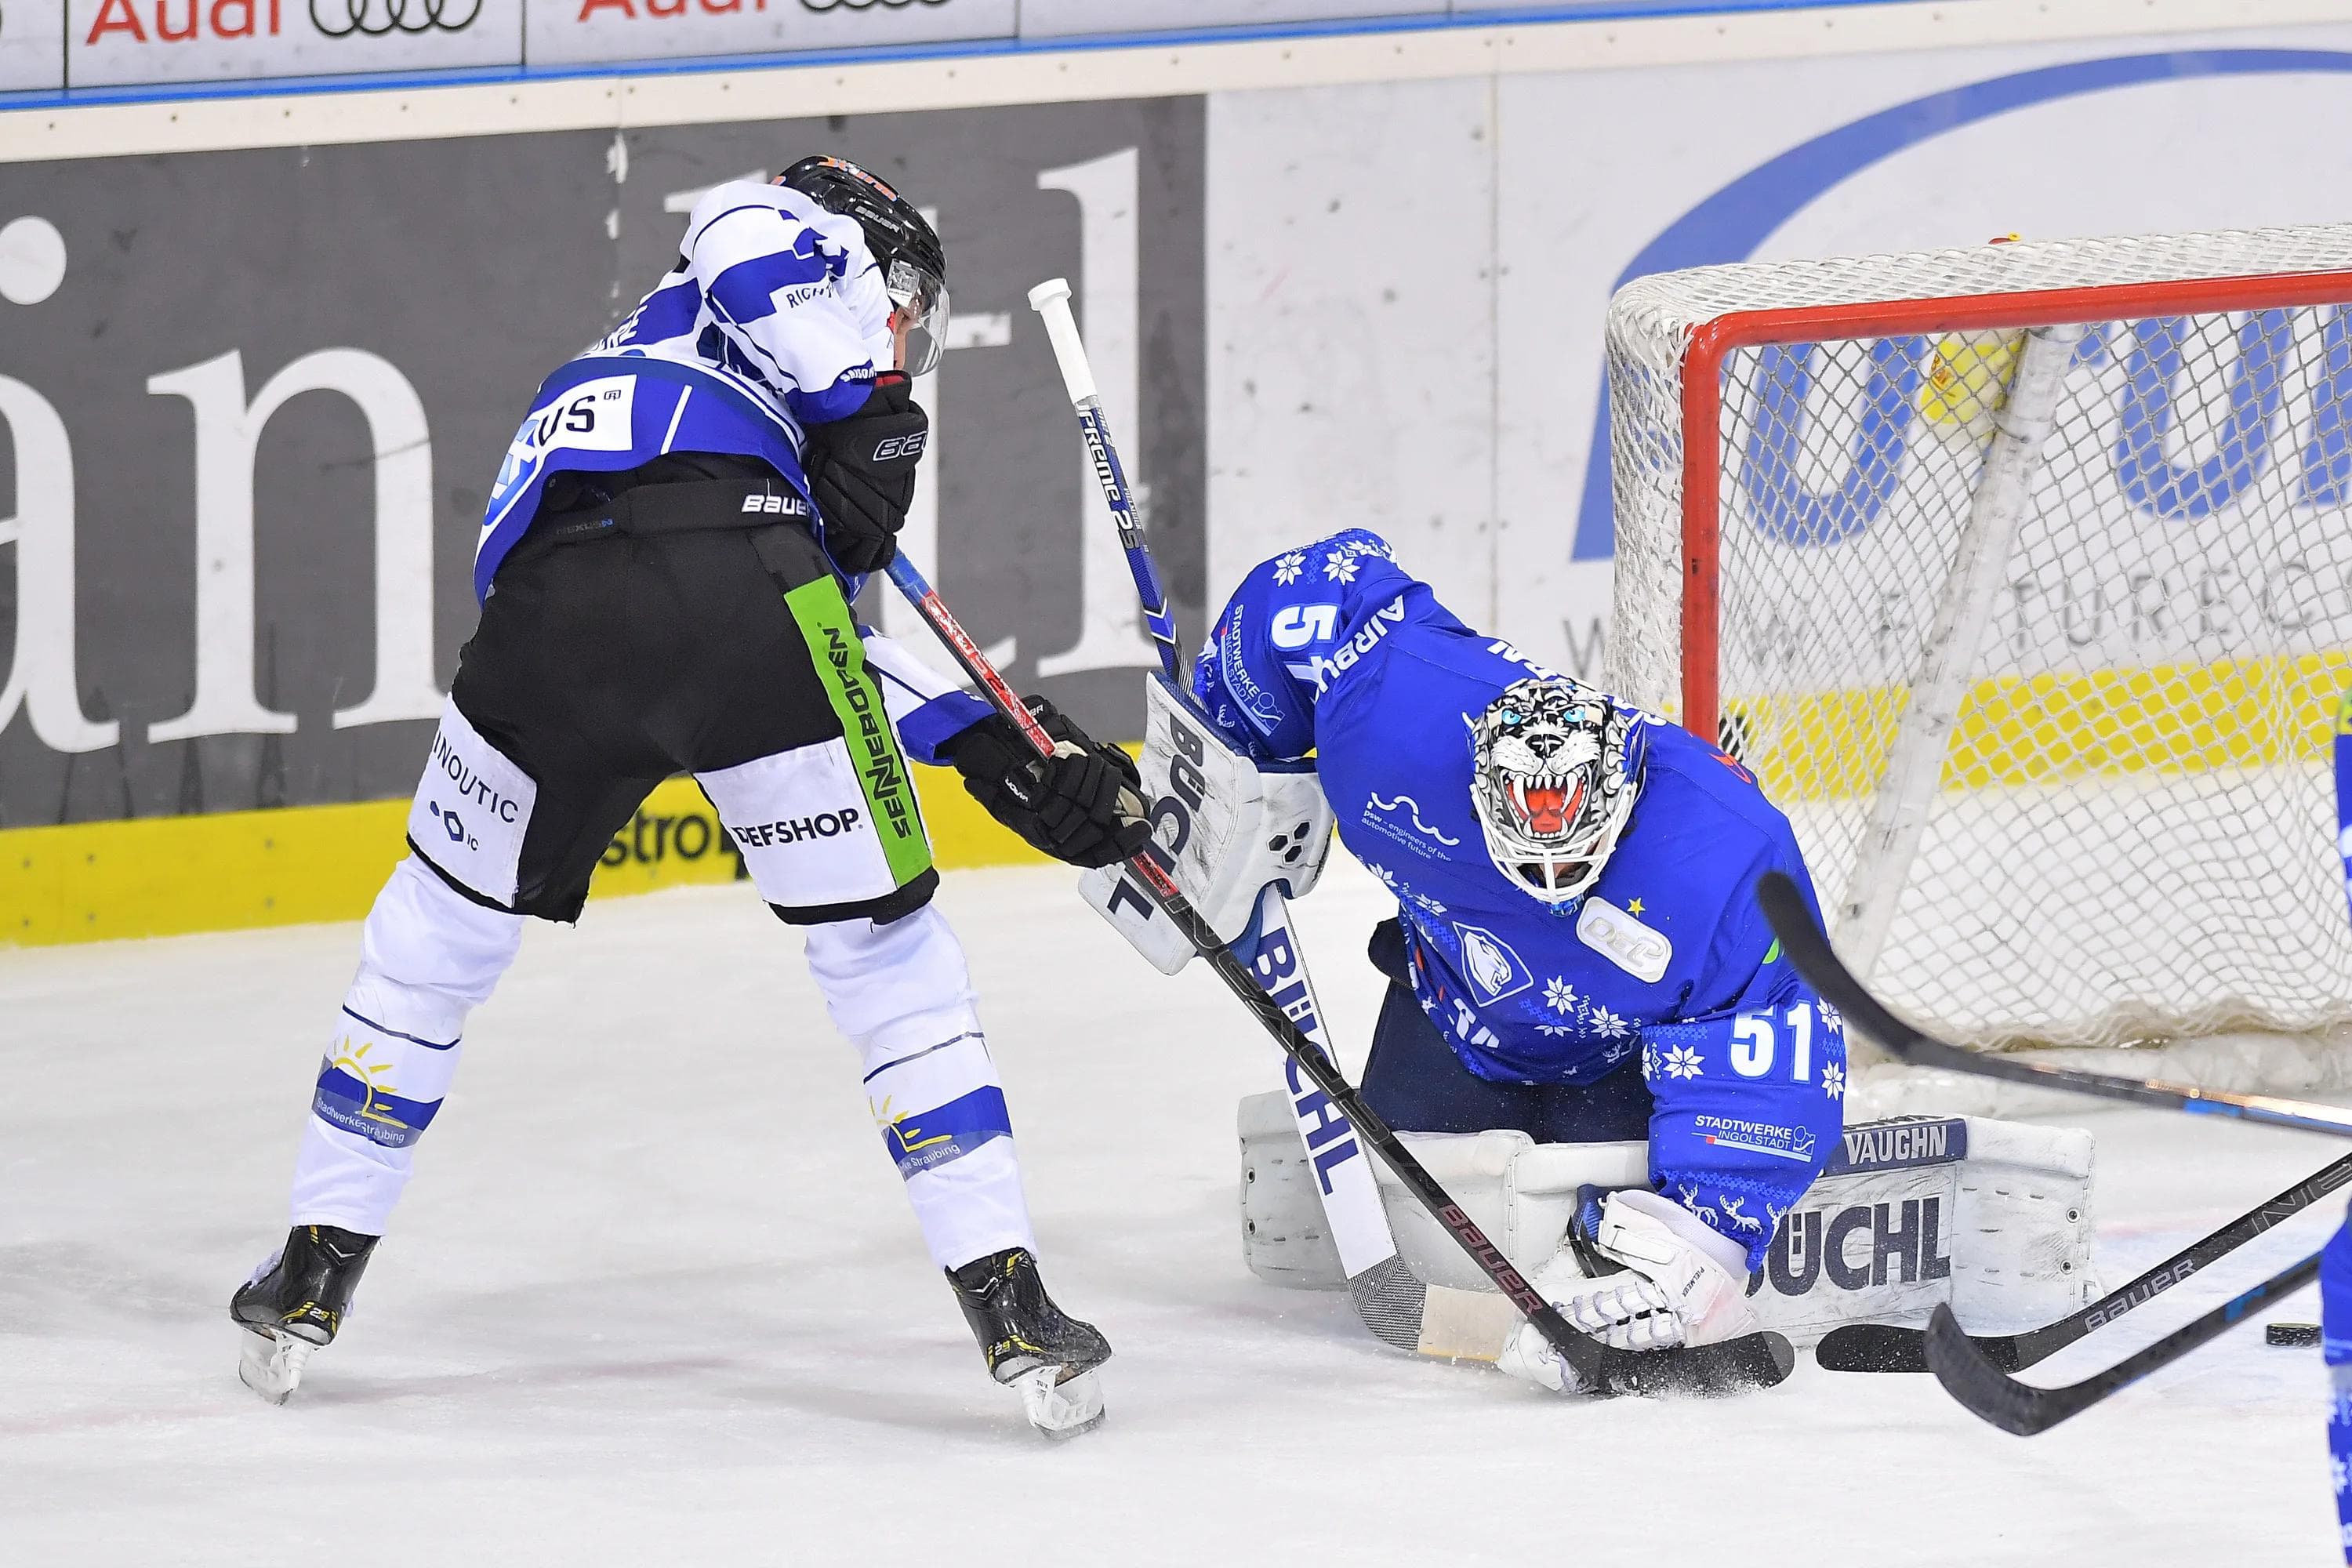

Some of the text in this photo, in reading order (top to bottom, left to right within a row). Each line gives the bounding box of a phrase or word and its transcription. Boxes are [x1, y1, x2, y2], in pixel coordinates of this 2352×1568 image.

[1225, 633, 1253, 704] INGOLSTADT
[1230, 604, 1261, 698] STADTWERKE
[1310, 594, 1406, 706] AIRBU
[822, 627, 911, 840] SENNEBOGEN
[433, 731, 519, 823] INOUTIC
[1361, 817, 1432, 860] automotive future
[1363, 809, 1383, 823] psw
[1388, 823, 1427, 849] engineers
[1427, 845, 1438, 855] of
[1437, 851, 1452, 862] the
[1730, 1000, 1813, 1083] 51
[1694, 1114, 1793, 1141] STADTWERKE
[1717, 1130, 1791, 1149] INGOLSTADT
[1844, 1124, 1947, 1166] VAUGHN
[1744, 1197, 1951, 1298] ÜCHL
